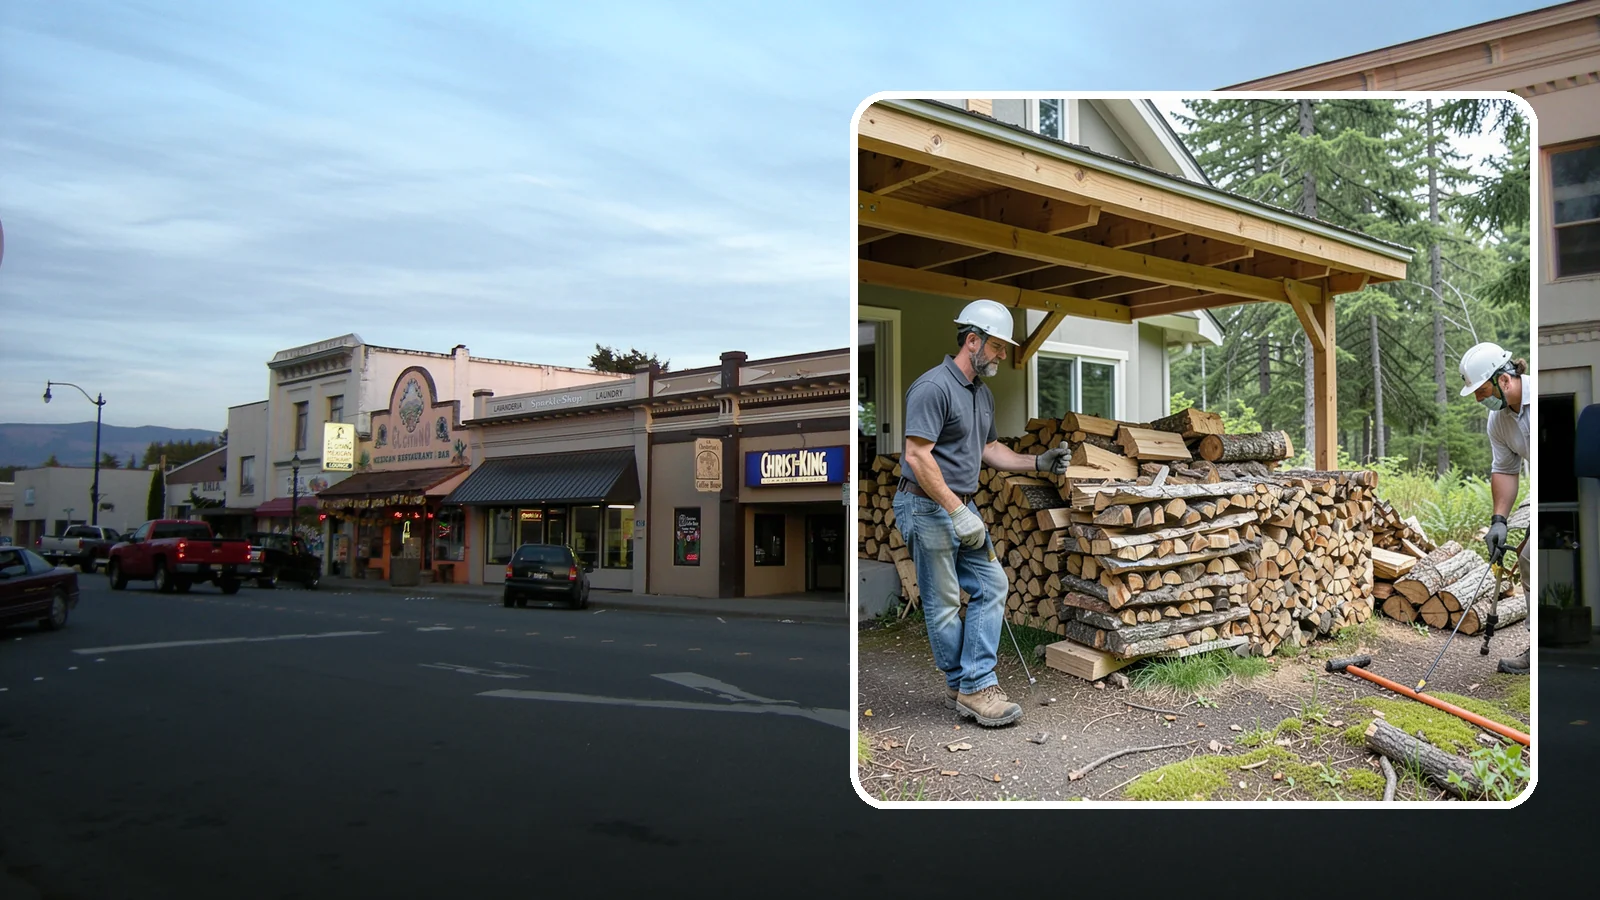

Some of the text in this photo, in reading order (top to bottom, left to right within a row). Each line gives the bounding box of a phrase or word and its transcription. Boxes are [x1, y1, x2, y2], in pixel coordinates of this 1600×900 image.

[595, 389, 623, 400] LAUNDRY
[493, 401, 523, 413] LAVANDERIA
[530, 395, 582, 410] Sparkle Shop
[373, 450, 450, 464] MEXICAN RESTAURANT BAR
[760, 450, 828, 478] CHRIST KING
